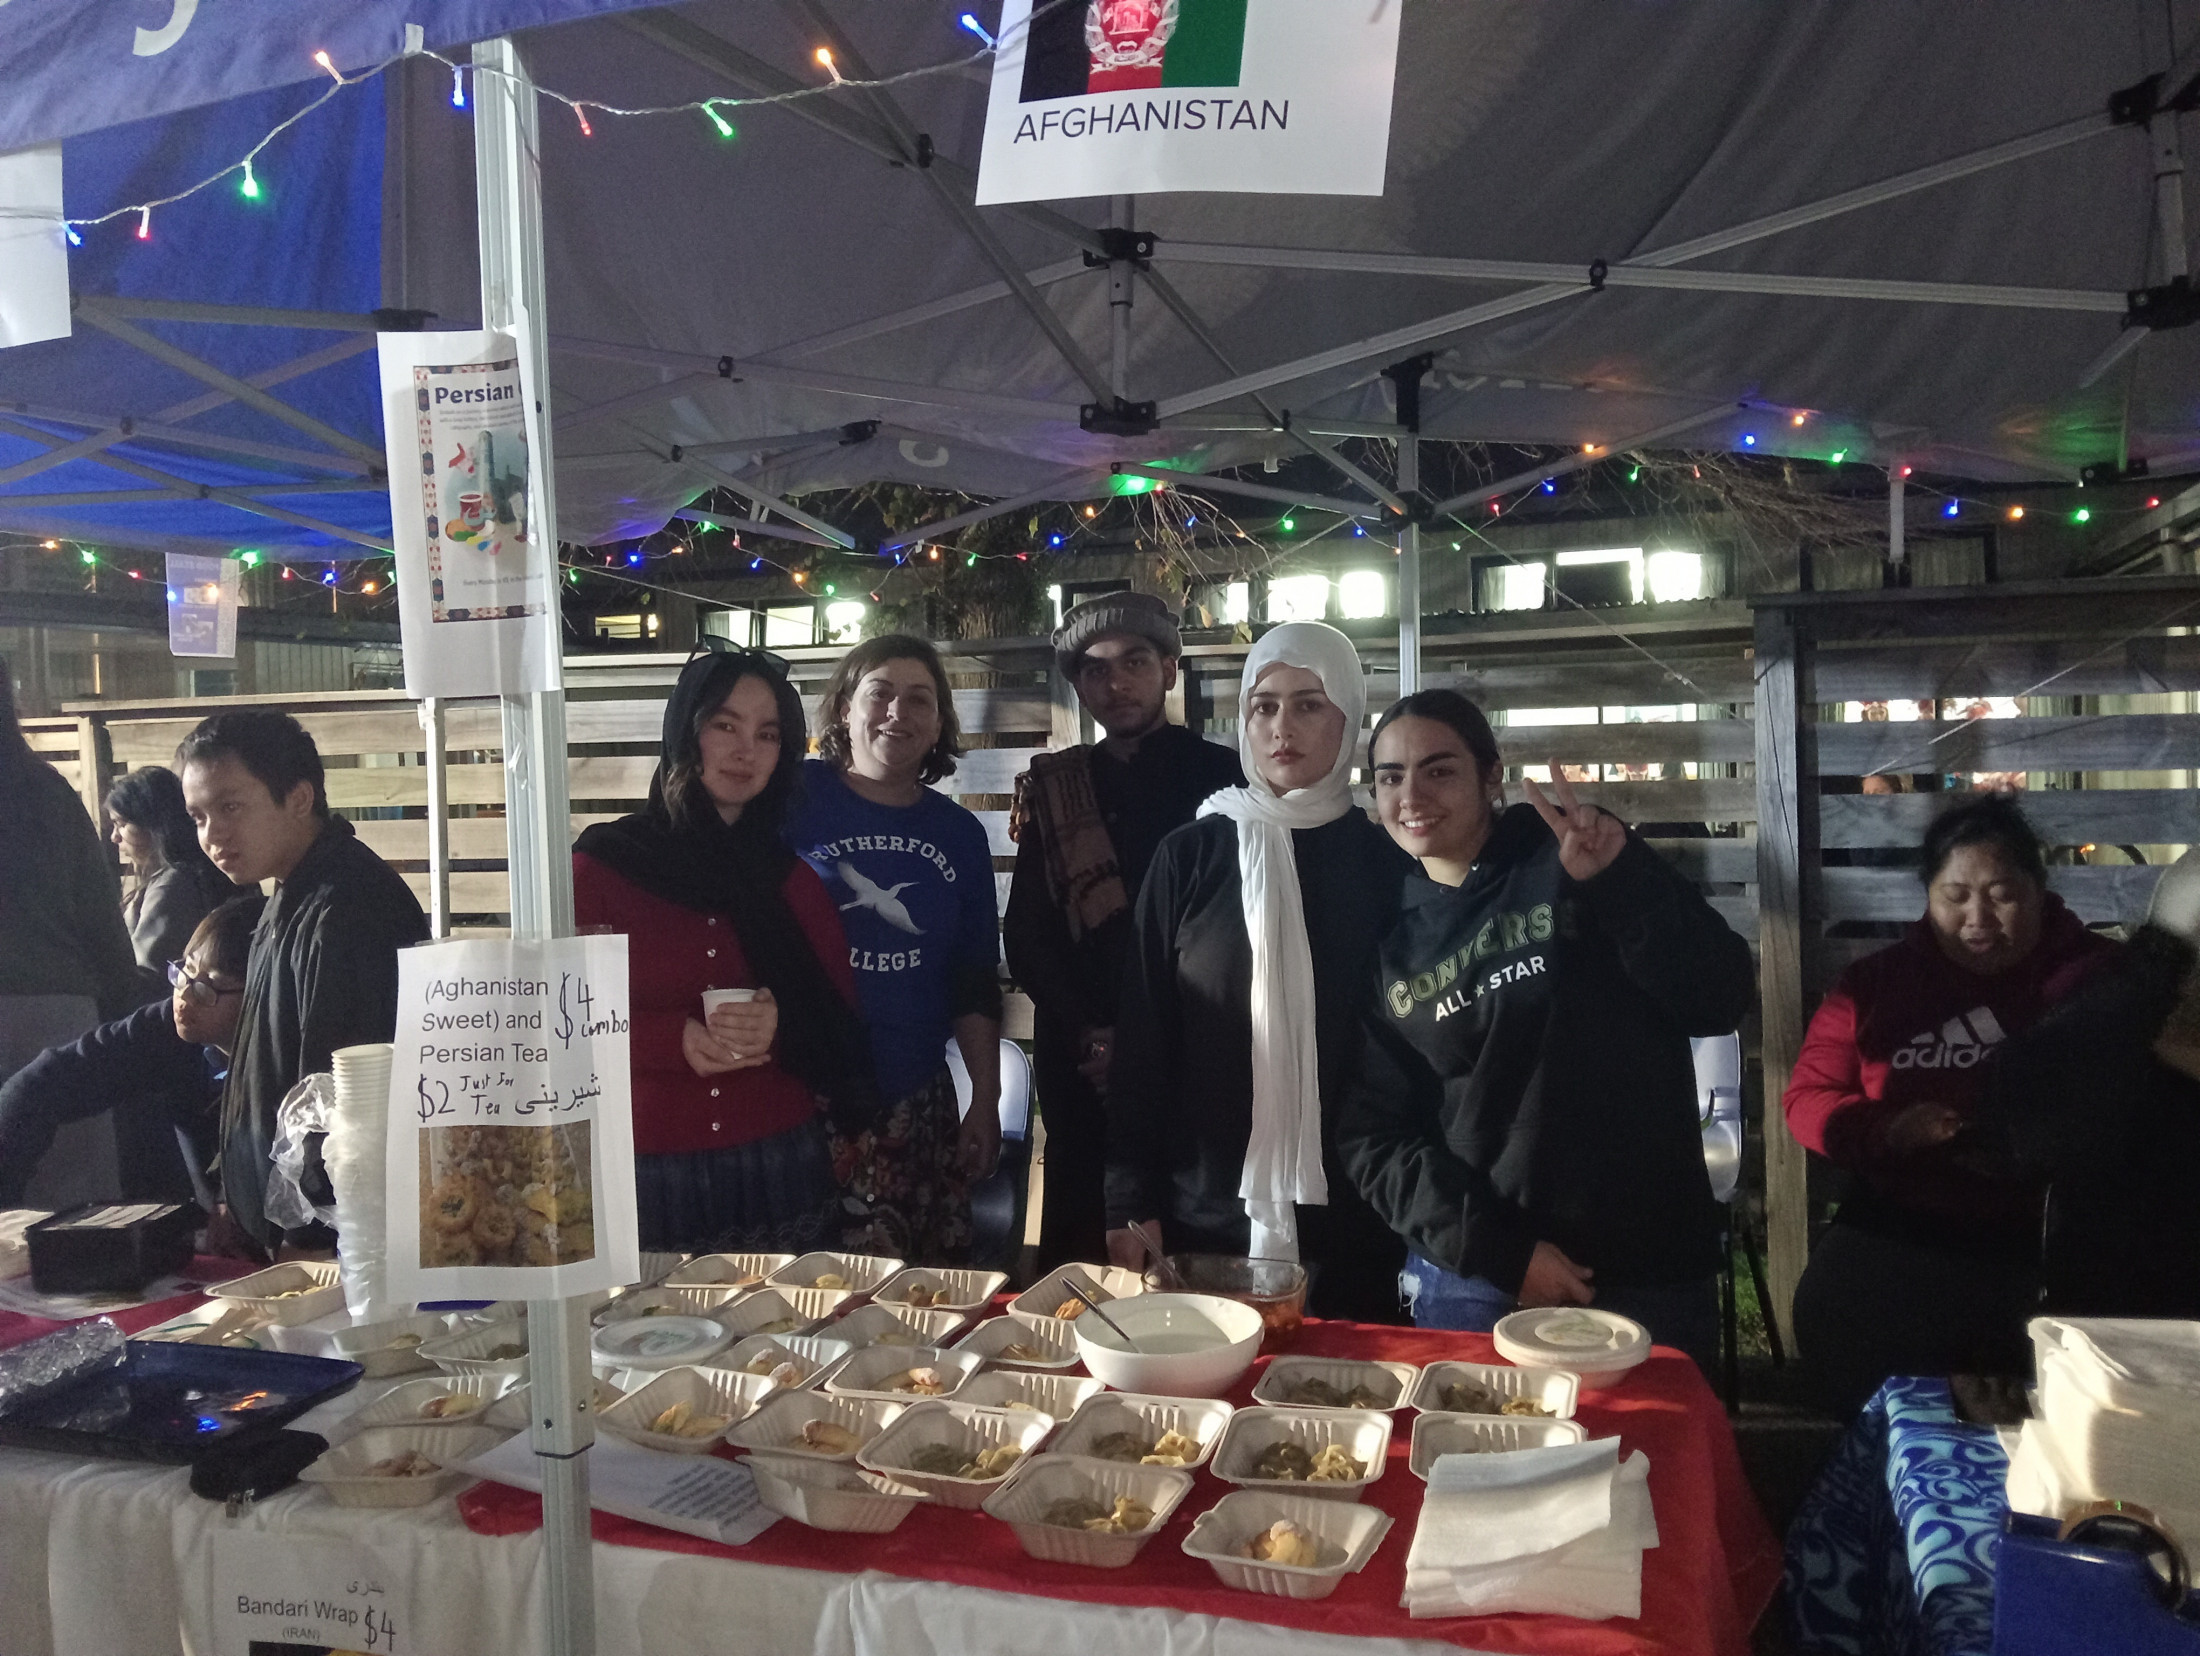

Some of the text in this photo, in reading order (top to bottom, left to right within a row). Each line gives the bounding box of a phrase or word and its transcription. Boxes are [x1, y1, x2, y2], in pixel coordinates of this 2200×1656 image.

[1014, 99, 1289, 144] AFGHANISTAN
[434, 382, 514, 404] Persian
[807, 835, 957, 883] RUTHERFORD
[1387, 902, 1556, 1018] CONVERS
[425, 977, 549, 1004] (Aghanistan
[555, 972, 594, 1049] $4
[1435, 955, 1546, 1021] ALL STAR
[422, 1009, 542, 1032] Sweet) and
[420, 1043, 549, 1064] Persian Tea
[417, 1074, 456, 1122] $2
[471, 1094, 501, 1115] Tea
[237, 1596, 359, 1627] Bandari Wrap
[364, 1604, 397, 1652] $4
